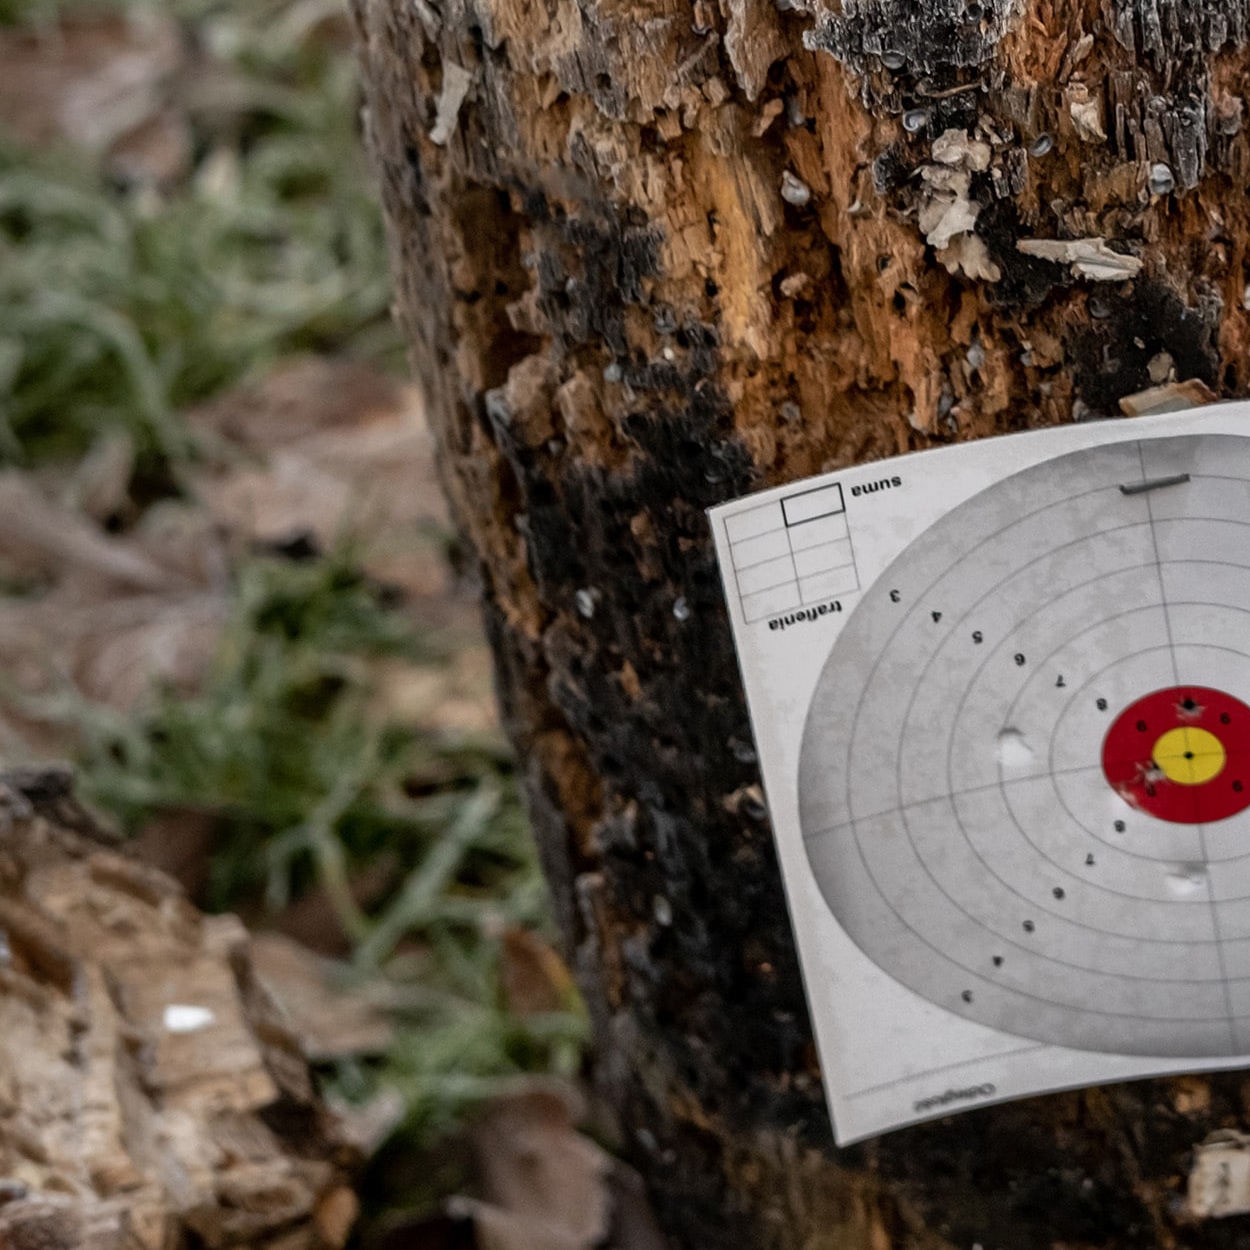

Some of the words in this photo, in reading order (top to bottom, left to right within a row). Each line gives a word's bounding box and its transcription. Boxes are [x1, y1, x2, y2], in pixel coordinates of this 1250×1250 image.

[850, 475, 903, 498] suma
[768, 599, 843, 631] trafienia
[889, 589, 901, 604] 3
[931, 611, 943, 624] 4
[971, 630, 984, 645] 5
[1014, 653, 1027, 667] 6
[1055, 675, 1067, 689] 7
[1096, 698, 1109, 713] 8
[961, 990, 973, 1004] 3
[1085, 853, 1096, 867] 7
